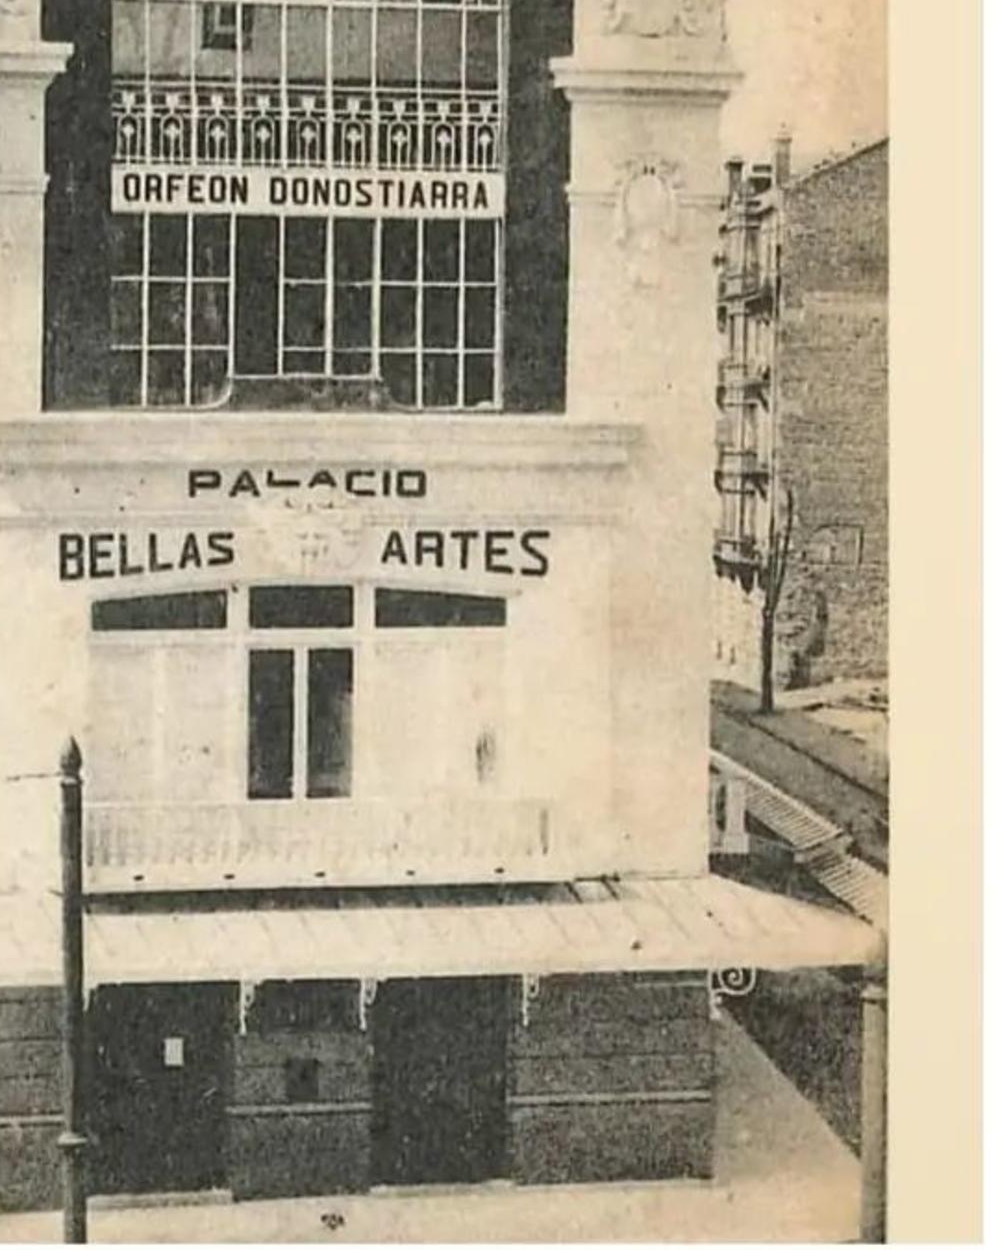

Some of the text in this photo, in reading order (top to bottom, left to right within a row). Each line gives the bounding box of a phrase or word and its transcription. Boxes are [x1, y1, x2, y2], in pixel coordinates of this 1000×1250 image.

[123, 173, 489, 209] ORFEON DONOSTIARRA
[188, 469, 427, 498] PALACIO
[59, 530, 550, 581] BELLAS ARTES
